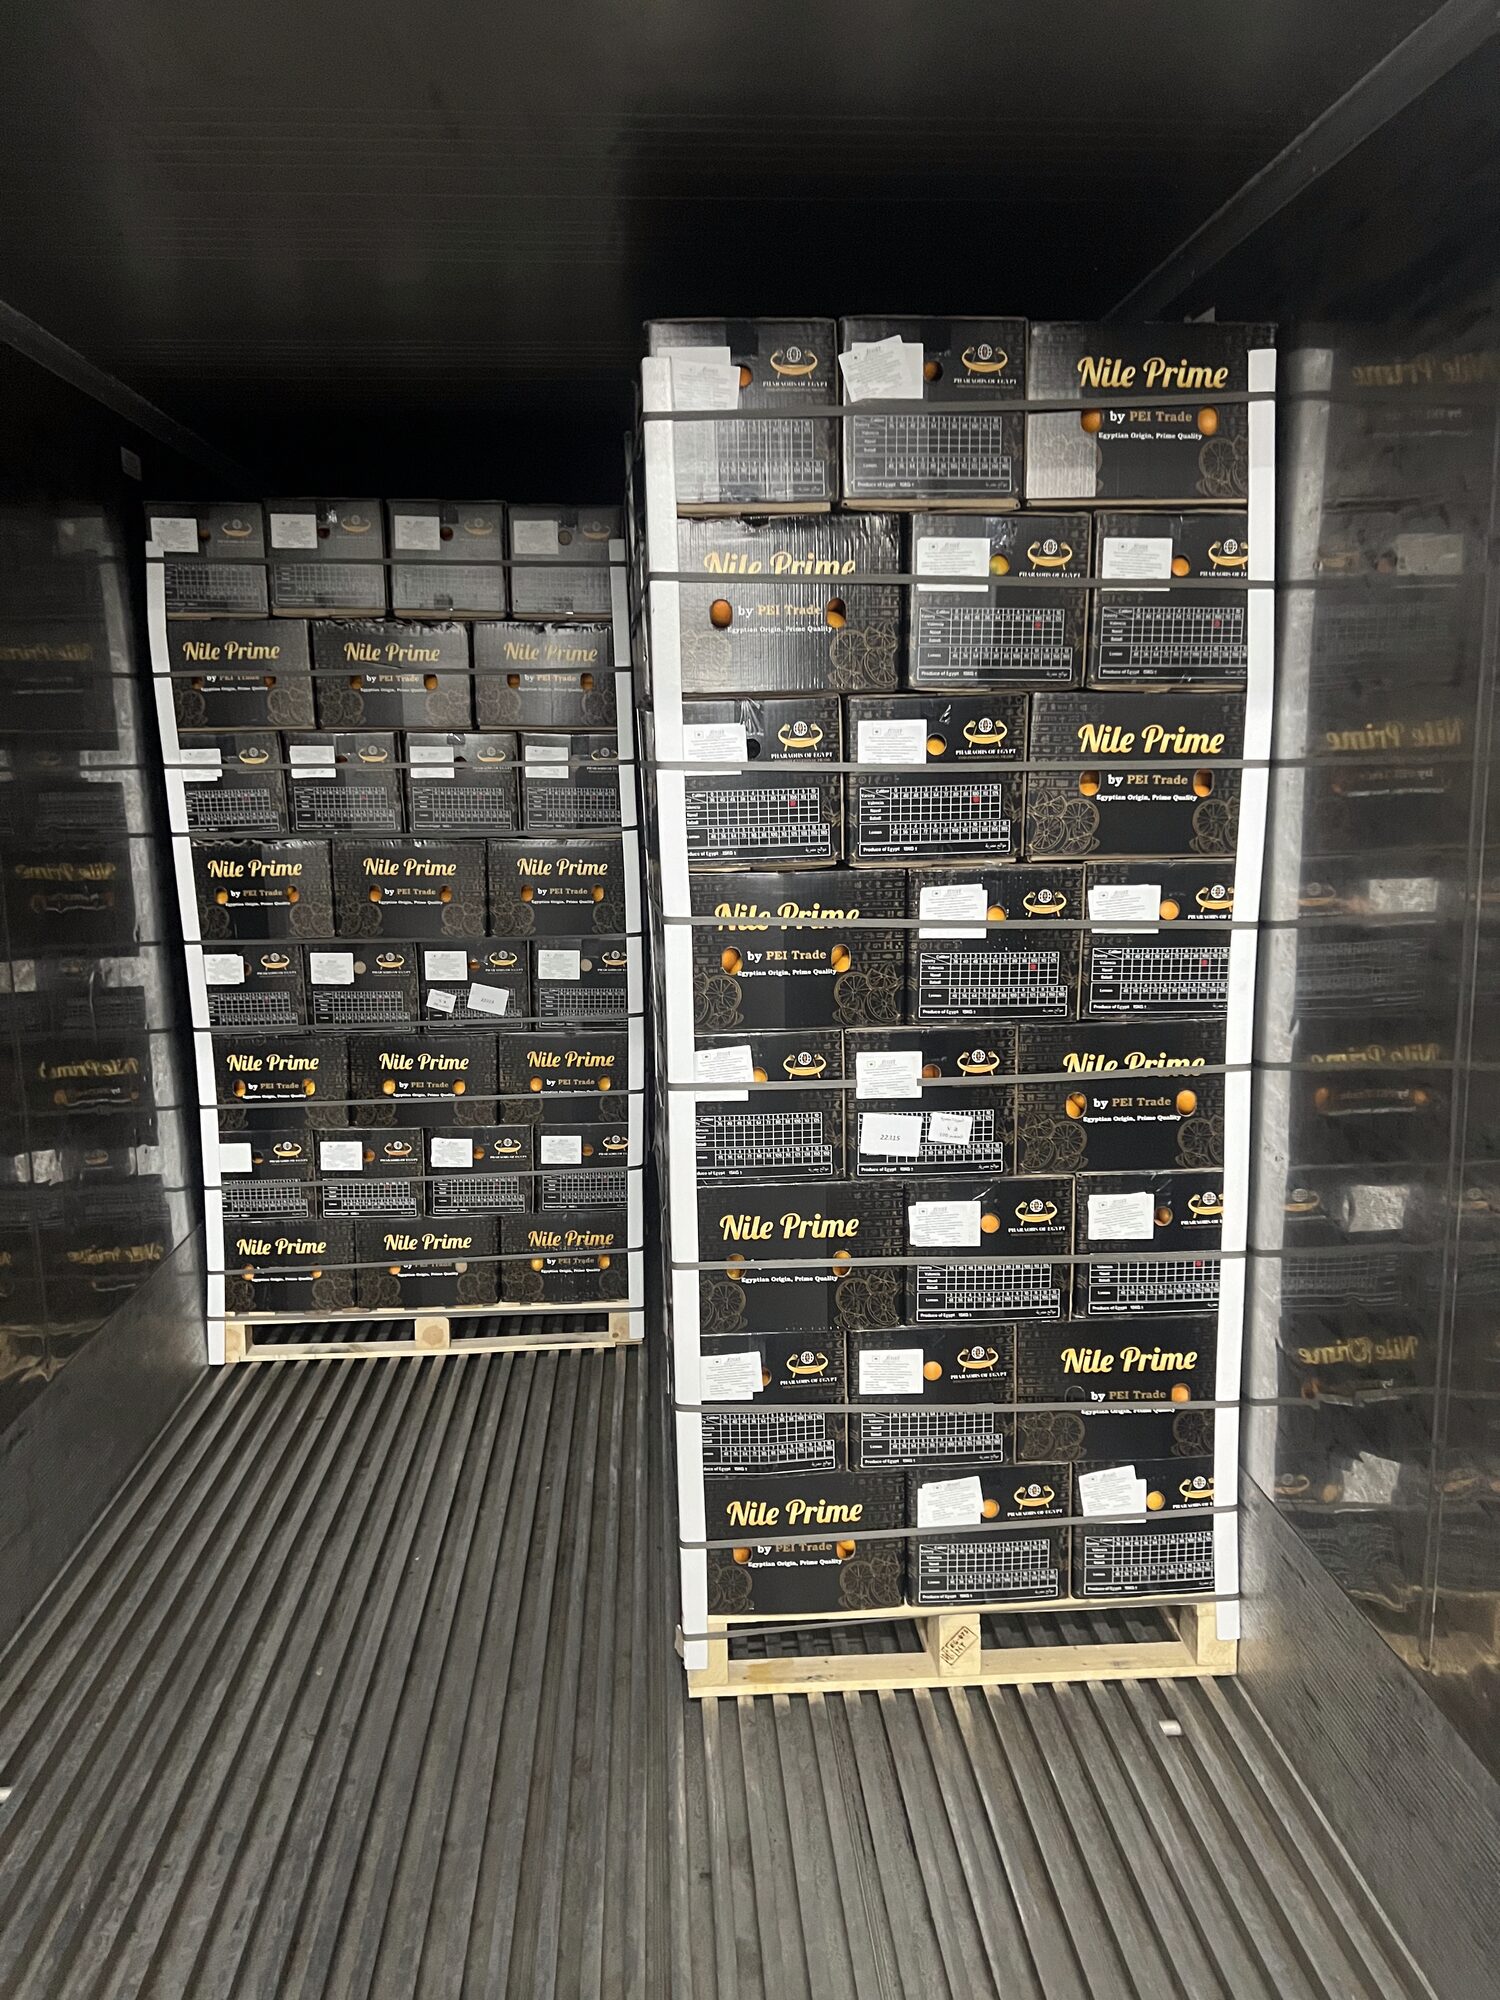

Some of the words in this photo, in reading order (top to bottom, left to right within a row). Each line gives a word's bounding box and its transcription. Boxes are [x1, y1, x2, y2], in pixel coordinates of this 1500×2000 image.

[1077, 356, 1136, 388] Nile
[1143, 356, 1229, 389] Prime
[1109, 410, 1126, 424] by
[1130, 410, 1152, 422] PEI
[1155, 410, 1192, 422] Trade
[1098, 432, 1129, 440] Egyptian
[1156, 432, 1176, 440] Prime
[1178, 432, 1202, 440] Quality
[738, 605, 754, 618] by
[757, 604, 780, 616] PEI
[784, 604, 822, 616] Trade
[182, 641, 221, 661] Nile
[224, 641, 280, 660] Prime
[344, 642, 381, 662] Nile
[385, 642, 440, 663] Prime
[503, 641, 540, 662] Nile
[544, 643, 598, 662] Prime
[1077, 723, 1136, 754] Nile
[1141, 724, 1225, 754] Prime
[1107, 774, 1124, 788] by
[1126, 774, 1148, 785] PEI
[1152, 774, 1188, 785] Trade
[1096, 794, 1126, 802] Egyptian
[1172, 794, 1198, 802] Quality
[207, 860, 244, 878] Nile
[248, 859, 302, 878] Prime
[363, 858, 400, 876] Nile
[403, 858, 457, 876] Prime
[516, 858, 552, 876] Nile
[556, 858, 608, 876] Prime
[230, 890, 240, 899] by
[260, 889, 283, 897] Trade
[384, 888, 394, 896] by
[396, 888, 411, 896] PEI
[412, 888, 436, 896] Trade
[537, 888, 548, 896] by
[714, 903, 771, 932] Nile
[747, 951, 762, 964] by
[766, 950, 788, 961] PEI
[791, 950, 827, 960] Trade
[737, 970, 766, 978] Egyptian
[813, 968, 837, 976] Quality
[226, 1054, 263, 1072] Nile
[266, 1053, 320, 1072] Prime
[378, 1052, 414, 1070] Nile
[417, 1053, 470, 1071] Prime
[526, 1051, 562, 1068] Nile
[564, 1050, 616, 1068] Prime
[248, 1083, 258, 1091] by
[277, 1082, 300, 1090] Trade
[398, 1082, 410, 1090] by
[546, 1078, 556, 1087] by
[573, 1078, 596, 1086] Trade
[1093, 1098, 1109, 1110] by
[1112, 1098, 1133, 1107] PEI
[1136, 1097, 1172, 1107] Trade
[1157, 1114, 1182, 1122] Quality
[719, 1214, 774, 1240] Nile
[780, 1212, 860, 1239] Prime
[383, 1234, 418, 1251] Nile
[422, 1234, 472, 1250] Prime
[528, 1230, 562, 1248] Nile
[565, 1230, 614, 1246] Prime
[236, 1238, 272, 1256] Nile
[275, 1238, 327, 1255] Prime
[741, 1276, 770, 1284] Egyptian
[1060, 1348, 1114, 1374] Nile
[1120, 1346, 1198, 1372] Prime
[1090, 1391, 1106, 1402] by
[1108, 1391, 1130, 1400] PEI
[1132, 1390, 1166, 1400] Trade
[726, 1500, 780, 1526] Nile
[785, 1498, 864, 1525] Prime
[757, 1545, 772, 1556] by
[775, 1544, 796, 1553] PEI
[799, 1542, 832, 1552] Trade
[819, 1558, 842, 1566] Quality
